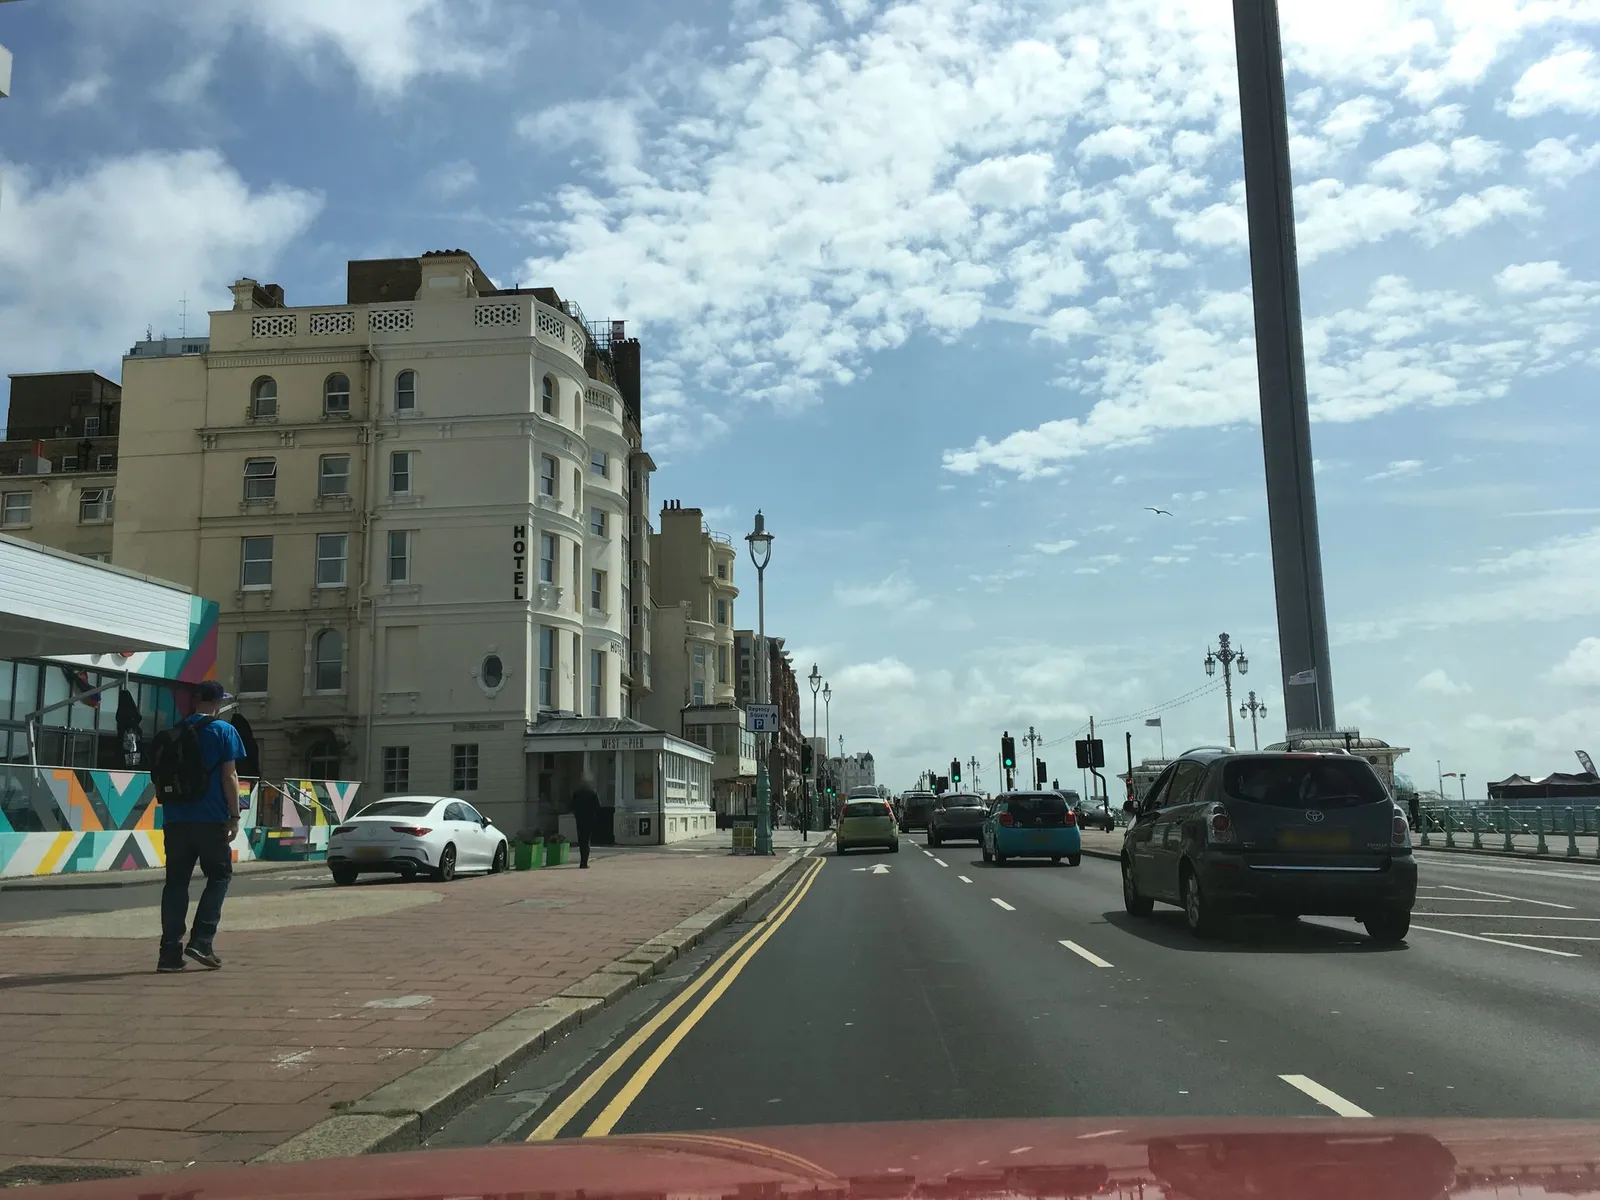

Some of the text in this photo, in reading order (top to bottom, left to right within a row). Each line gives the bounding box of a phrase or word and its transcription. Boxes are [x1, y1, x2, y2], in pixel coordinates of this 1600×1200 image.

[513, 525, 525, 600] HOTEL
[610, 641, 622, 656] HOTE
[601, 738, 619, 748] WEST
[628, 737, 644, 748] PIER
